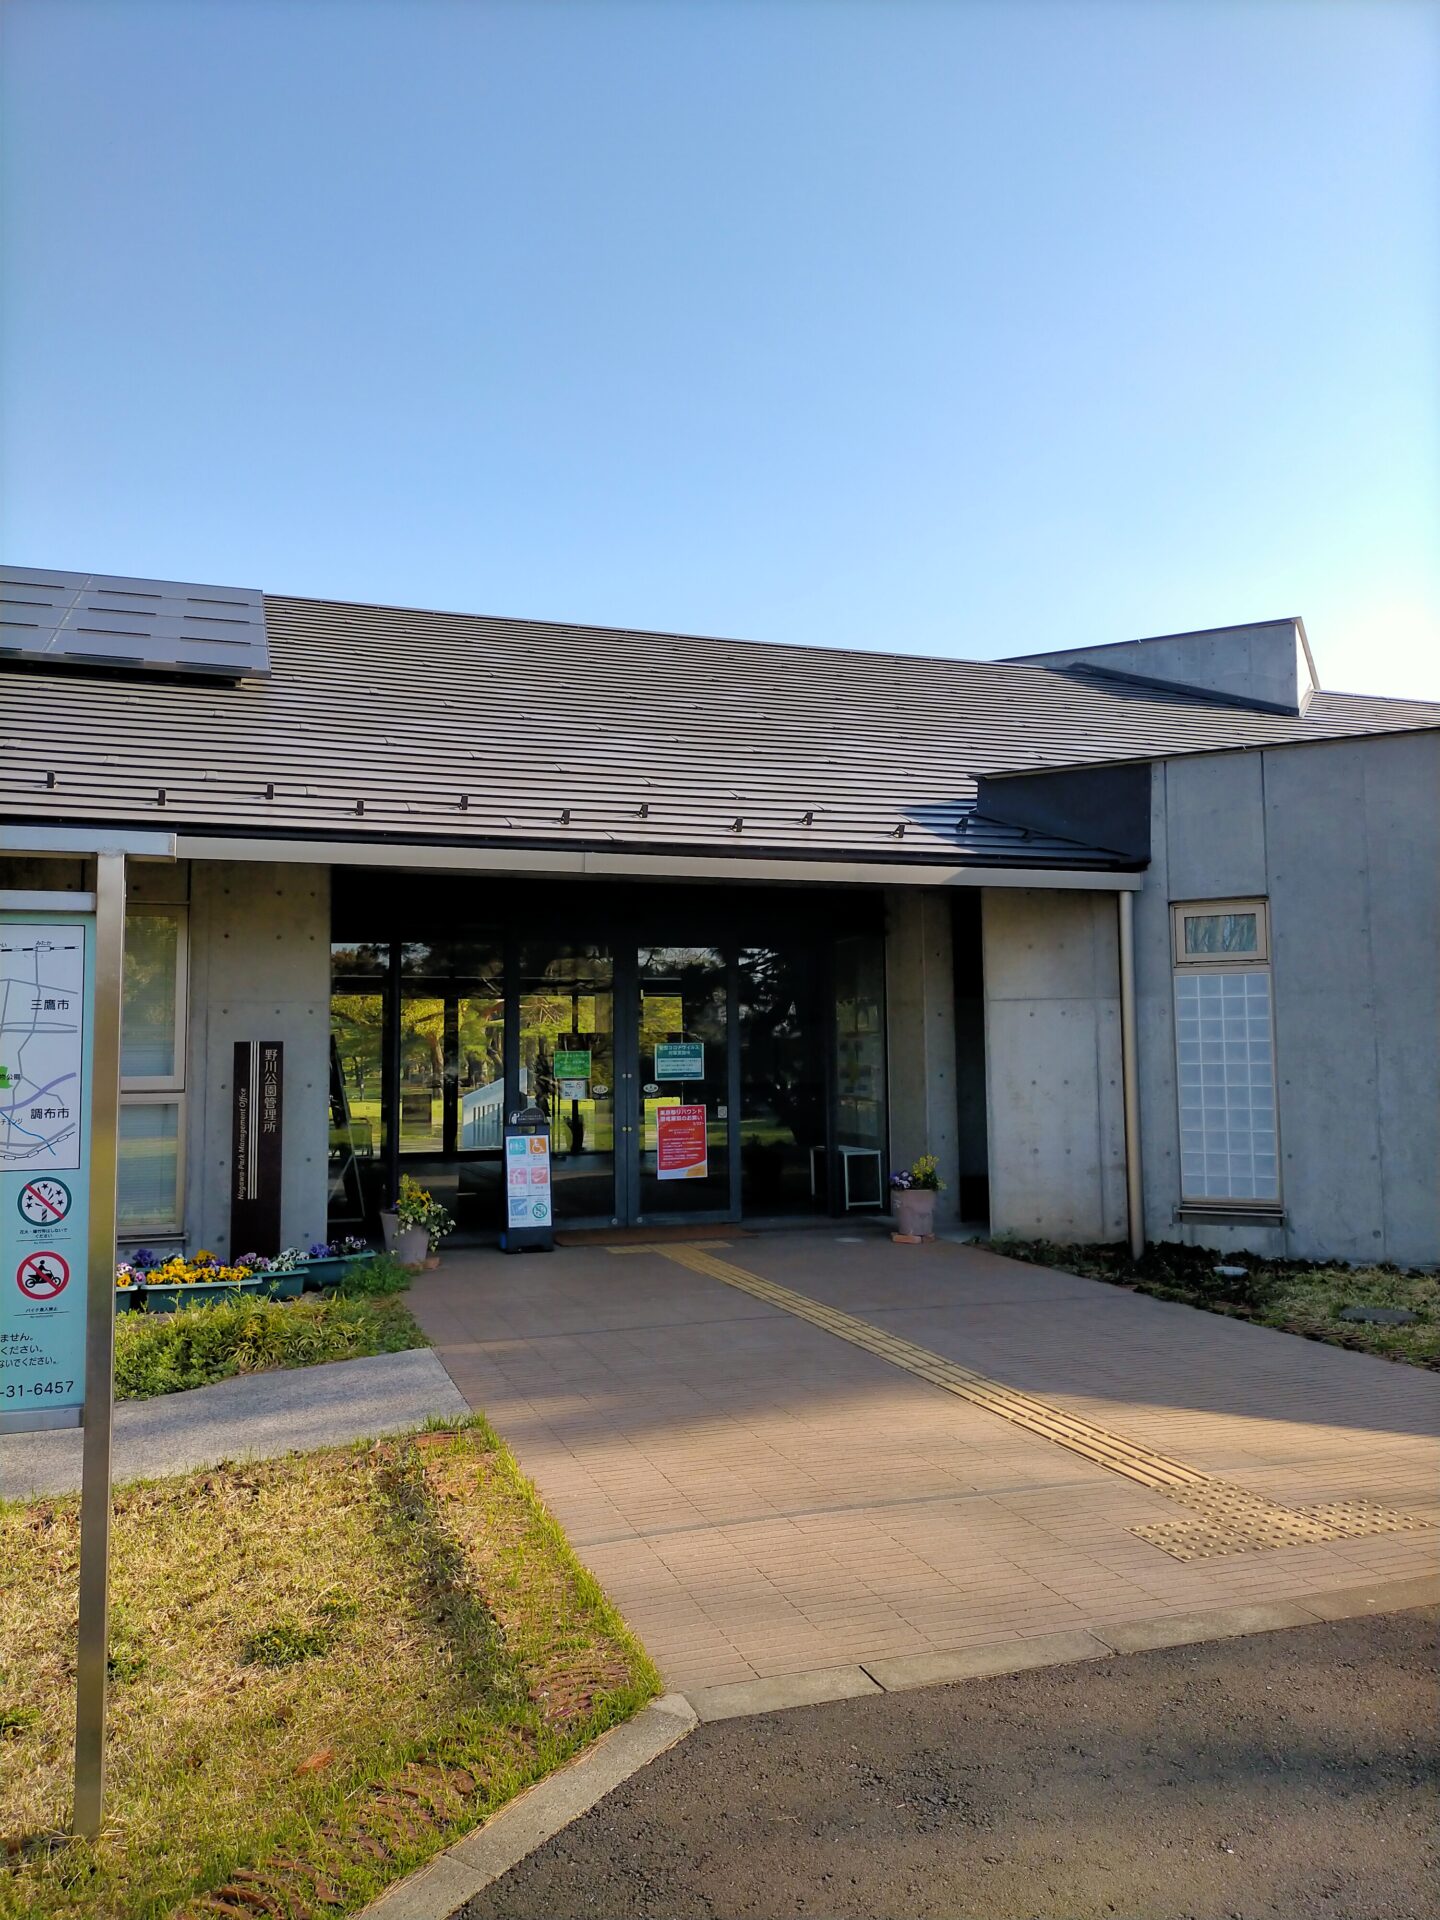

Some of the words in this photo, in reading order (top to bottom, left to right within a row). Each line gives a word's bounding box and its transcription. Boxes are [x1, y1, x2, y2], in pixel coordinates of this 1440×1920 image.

[31, 999, 69, 1010] 三鷹市
[239, 1087, 248, 1108] Office
[263, 1049, 278, 1133] 野川公園管理所
[30, 1107, 70, 1120] 調布市
[238, 1109, 248, 1153] Management
[237, 1154, 246, 1170] Park
[237, 1171, 247, 1200] Nogawa
[0, 1381, 74, 1398] -31-6457
